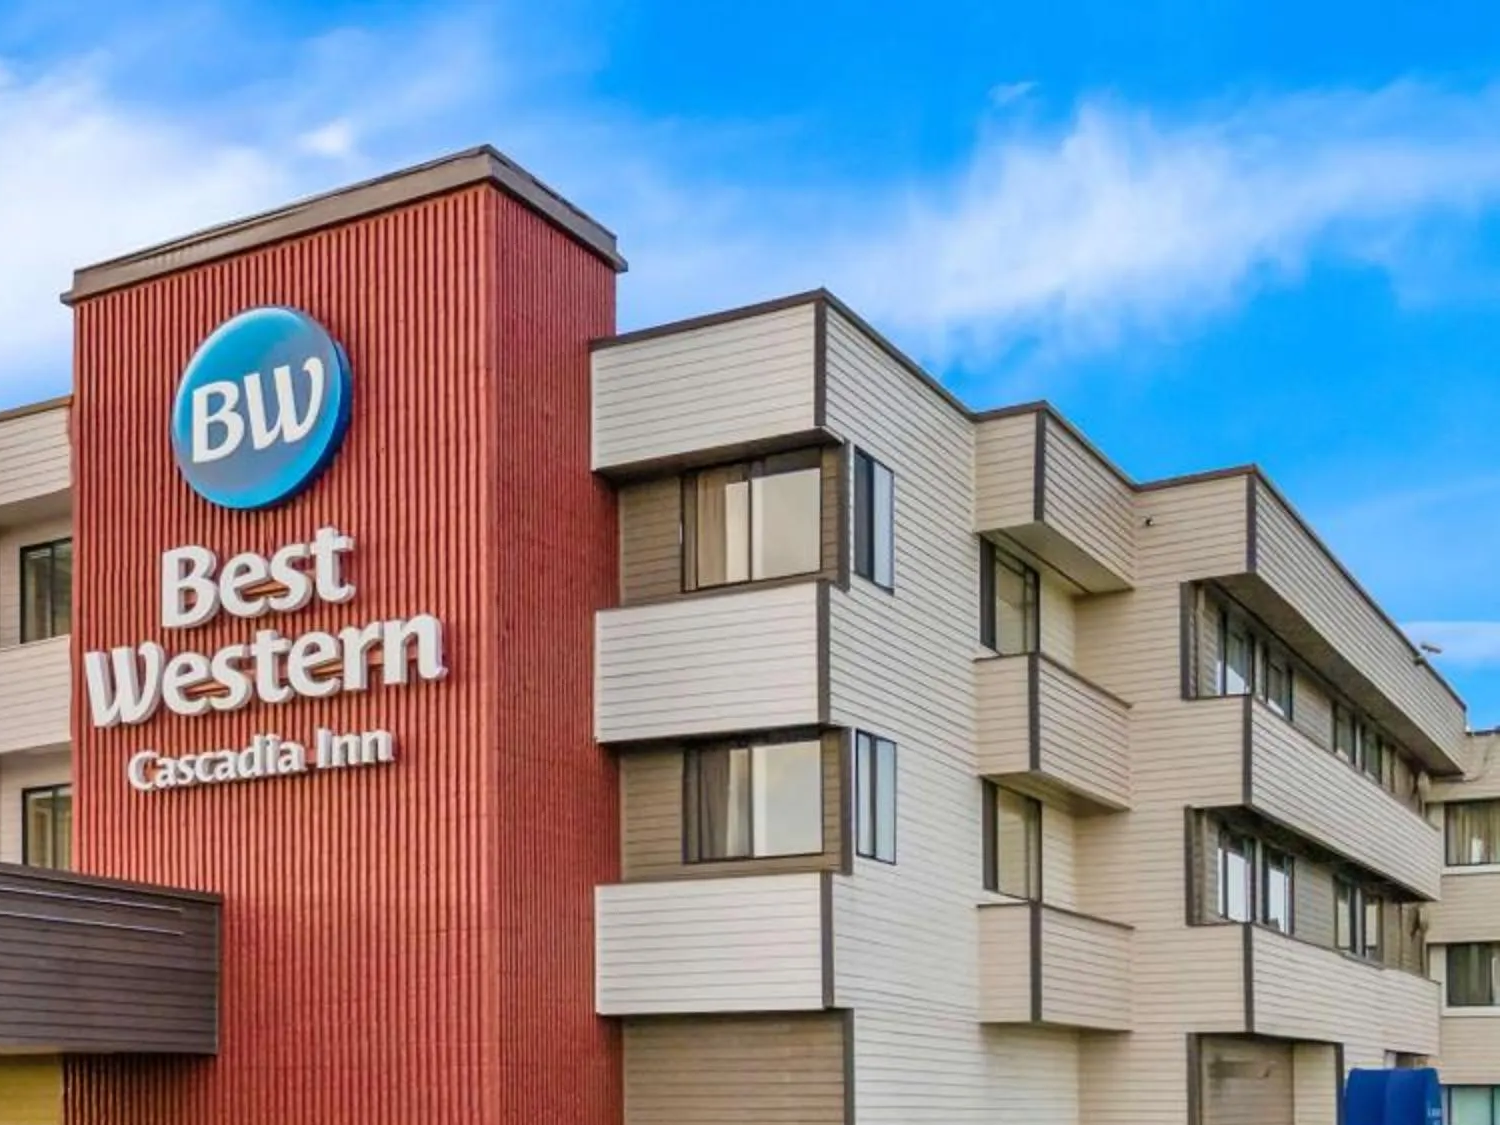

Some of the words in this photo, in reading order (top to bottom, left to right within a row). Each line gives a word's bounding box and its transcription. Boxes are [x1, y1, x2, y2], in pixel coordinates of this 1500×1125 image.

[191, 356, 325, 464] BW
[161, 525, 356, 628] Best
[127, 733, 307, 791] Cascadia
[316, 727, 394, 770] Inn
